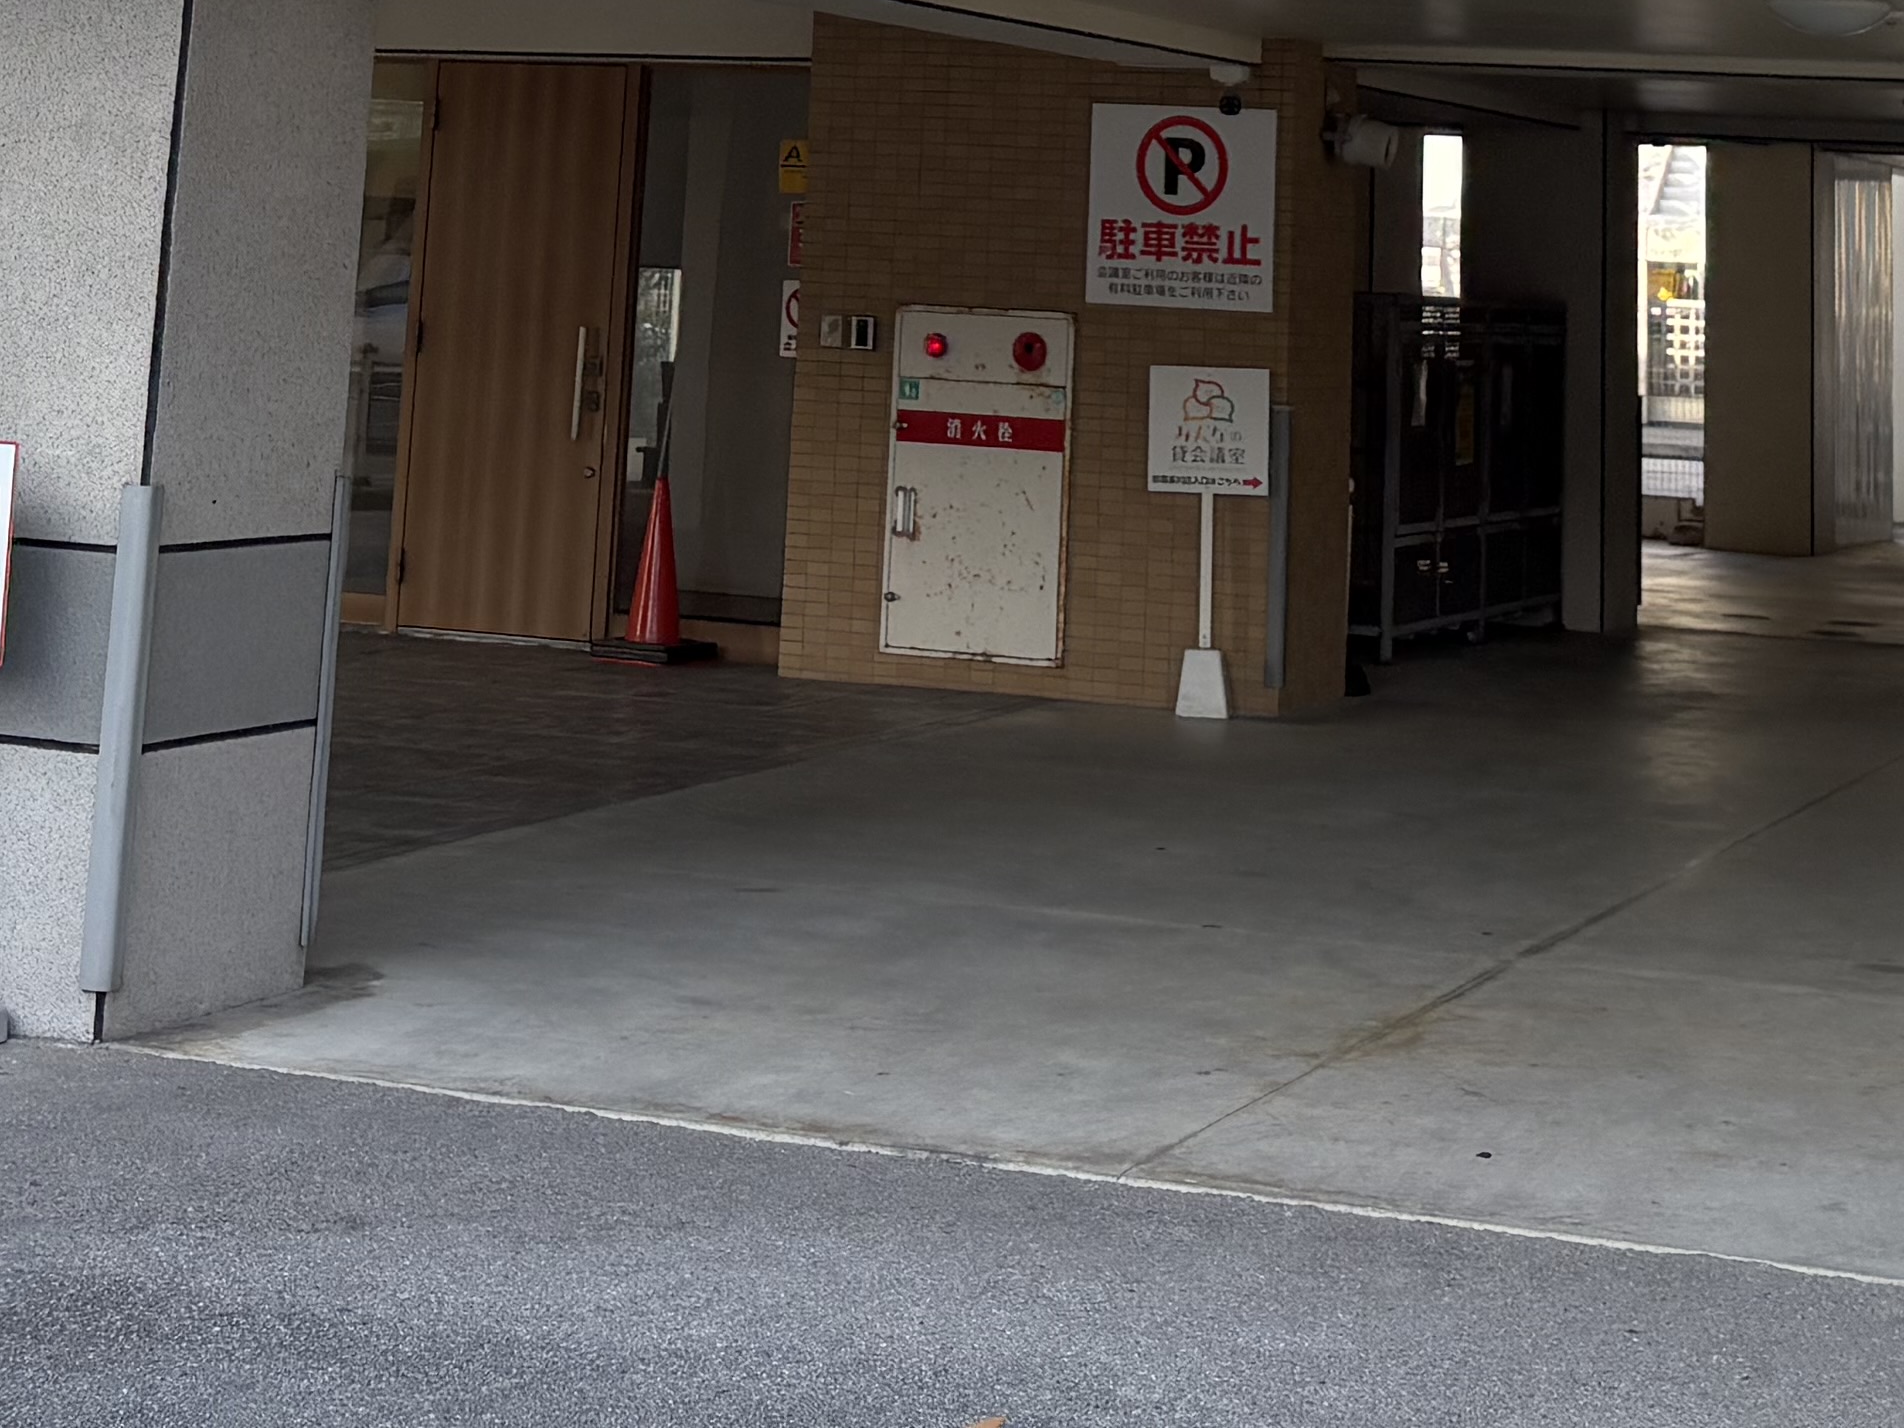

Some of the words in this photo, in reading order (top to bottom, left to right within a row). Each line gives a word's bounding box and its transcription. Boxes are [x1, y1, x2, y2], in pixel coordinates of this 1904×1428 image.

[1098, 218, 1262, 266] 駐車禁止
[947, 418, 1013, 443] 消火栓
